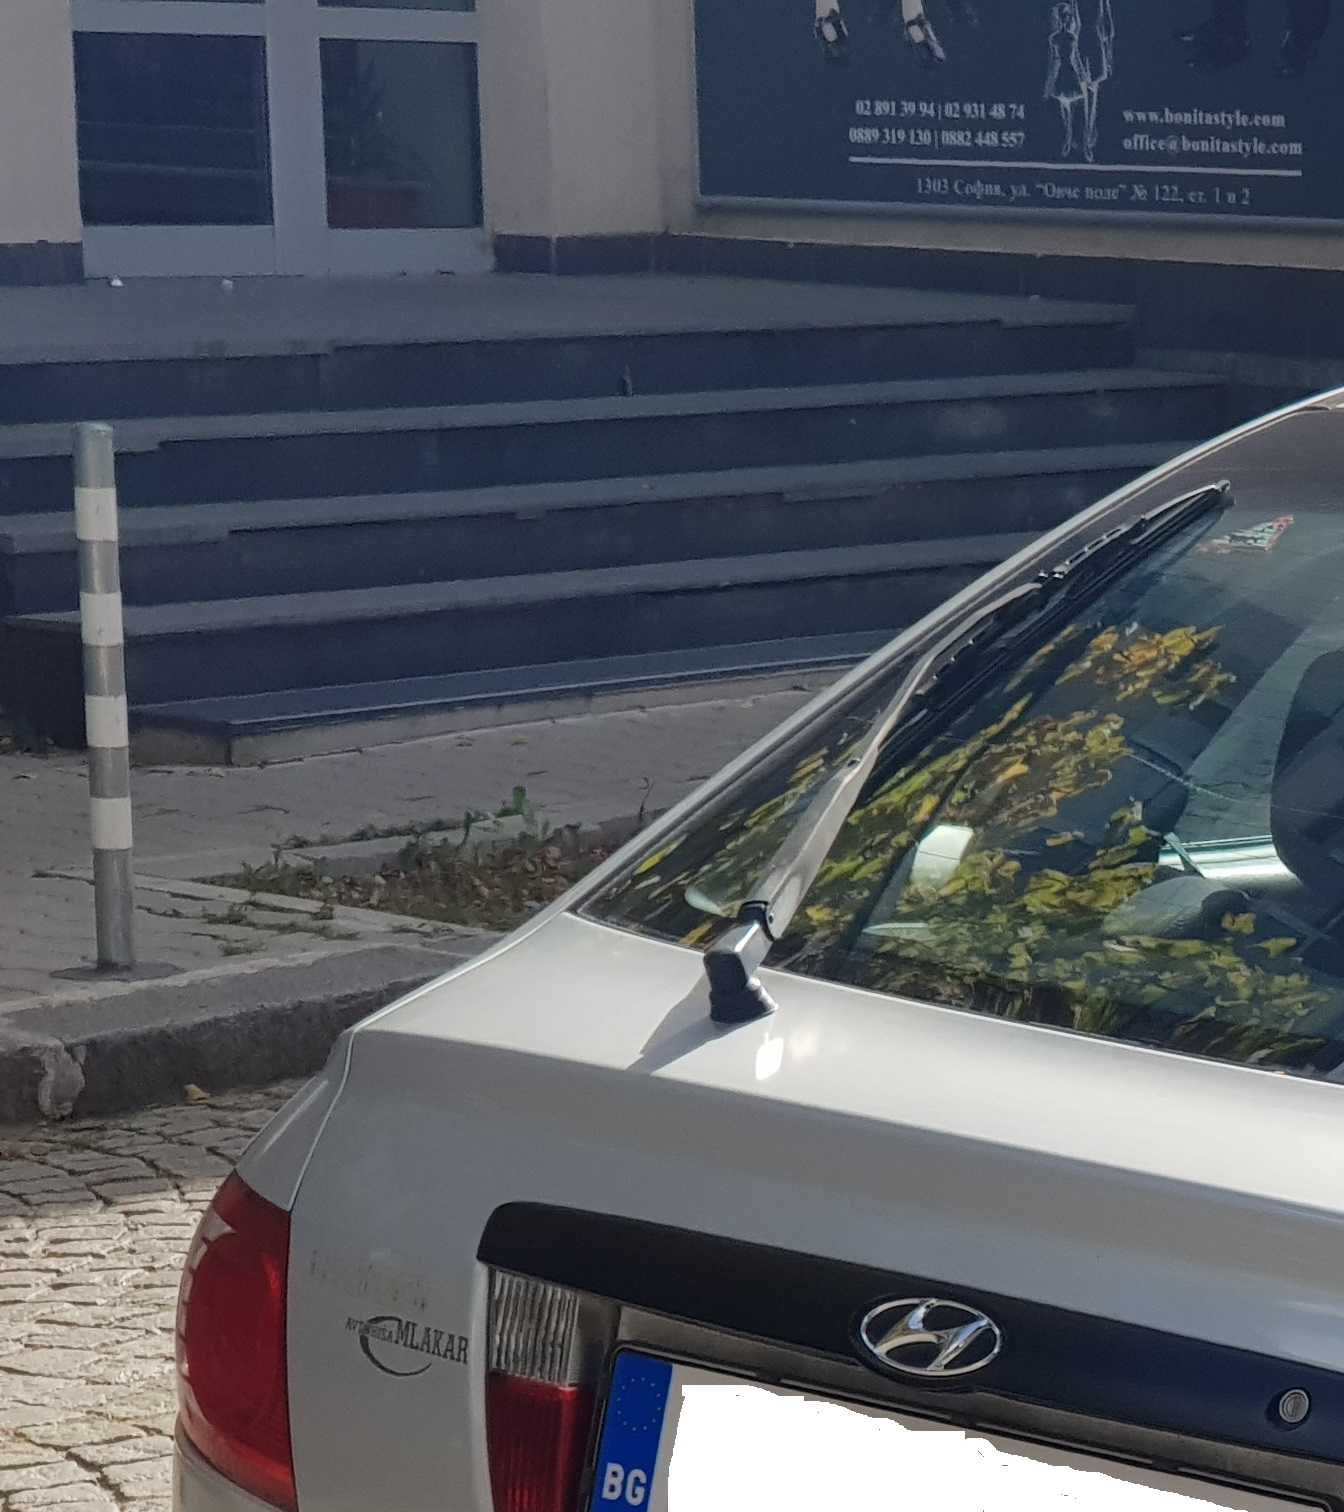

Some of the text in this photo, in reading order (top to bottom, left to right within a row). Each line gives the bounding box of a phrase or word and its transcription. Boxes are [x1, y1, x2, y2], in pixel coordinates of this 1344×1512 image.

[855, 100, 1025, 120] 02 891 39 94 02 931 48 74
[1122, 108, 1286, 130] www.bonitastyle.com
[849, 127, 1026, 148] 0889 319 130 0882 448 557
[1122, 133, 1303, 158] office@bonitastyle.com
[916, 177, 950, 195] 1303
[601, 1462, 648, 1507] BG
